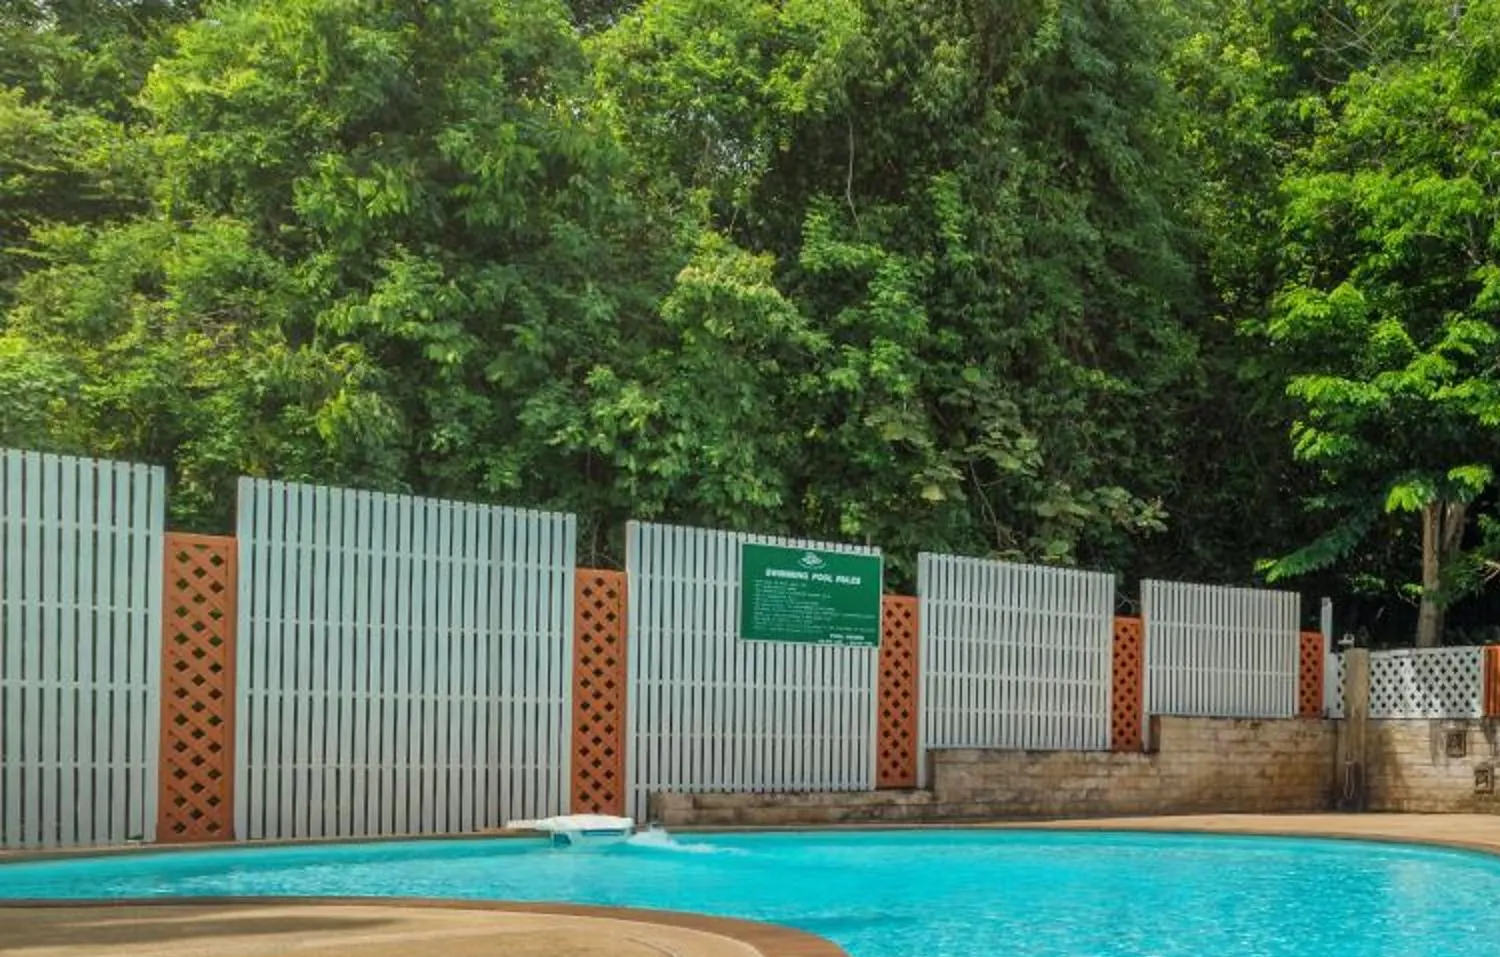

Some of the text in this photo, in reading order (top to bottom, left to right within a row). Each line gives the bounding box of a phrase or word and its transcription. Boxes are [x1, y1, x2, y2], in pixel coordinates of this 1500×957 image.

[765, 568, 862, 585] SWIMMING POOL RULES
